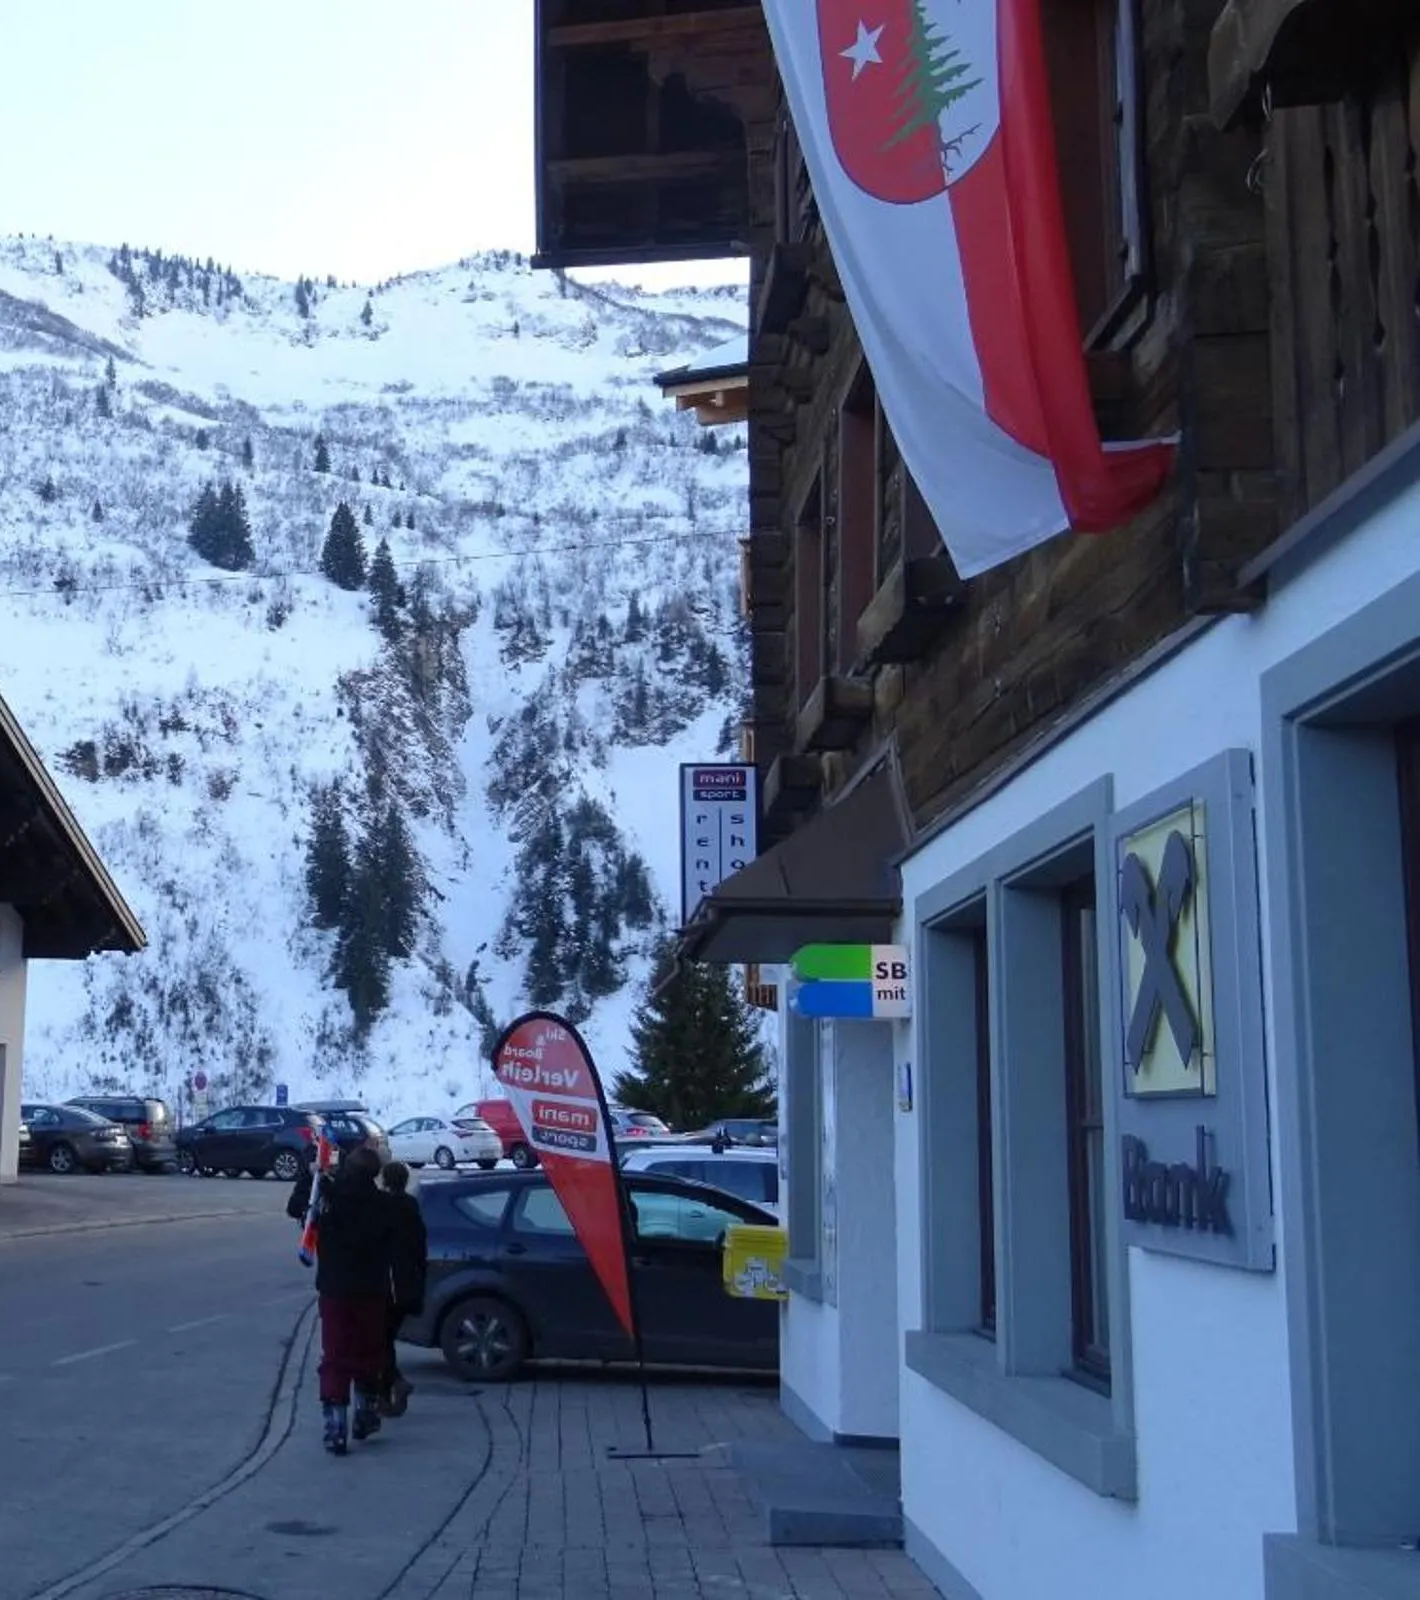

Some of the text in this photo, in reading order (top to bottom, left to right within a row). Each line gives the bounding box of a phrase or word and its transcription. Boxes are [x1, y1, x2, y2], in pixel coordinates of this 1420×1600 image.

[699, 772, 741, 785] mani
[699, 789, 741, 800] sport
[730, 813, 746, 871] sho
[875, 961, 908, 980] SB
[877, 986, 906, 1001] mit
